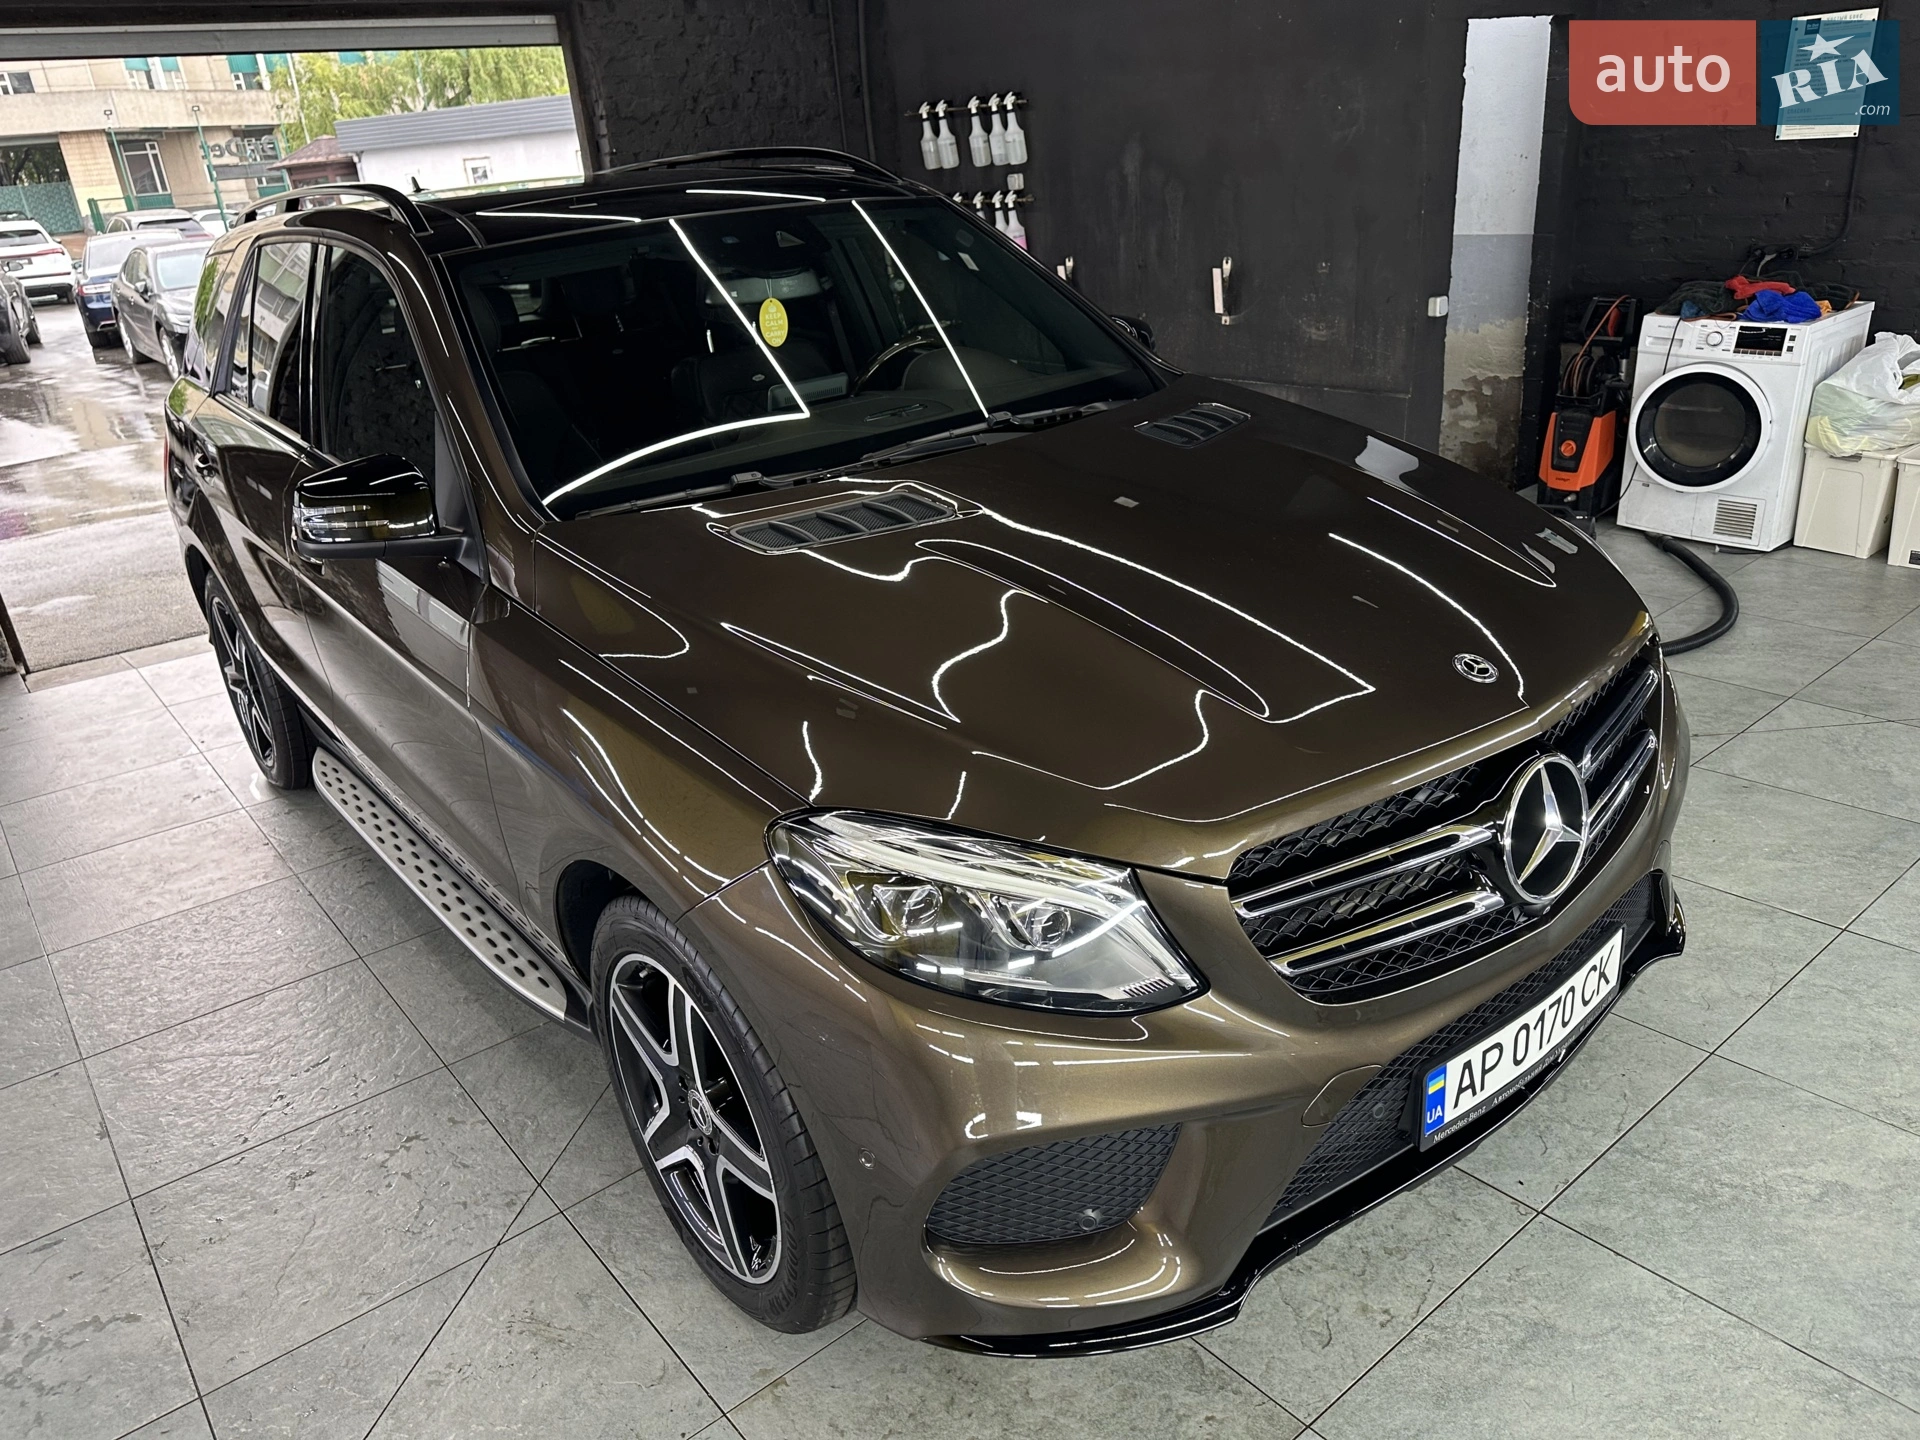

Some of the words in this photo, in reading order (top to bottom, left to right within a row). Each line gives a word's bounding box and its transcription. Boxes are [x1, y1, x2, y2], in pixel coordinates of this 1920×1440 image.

[765, 312, 782, 320] KEEP
[765, 319, 784, 327] CALM
[1453, 1041, 1504, 1110] AP
[1512, 985, 1576, 1067] 0170
[1581, 944, 1615, 1007] CK
[1427, 1104, 1443, 1124] UA
[1433, 1105, 1486, 1143] Mercedes-Benz
